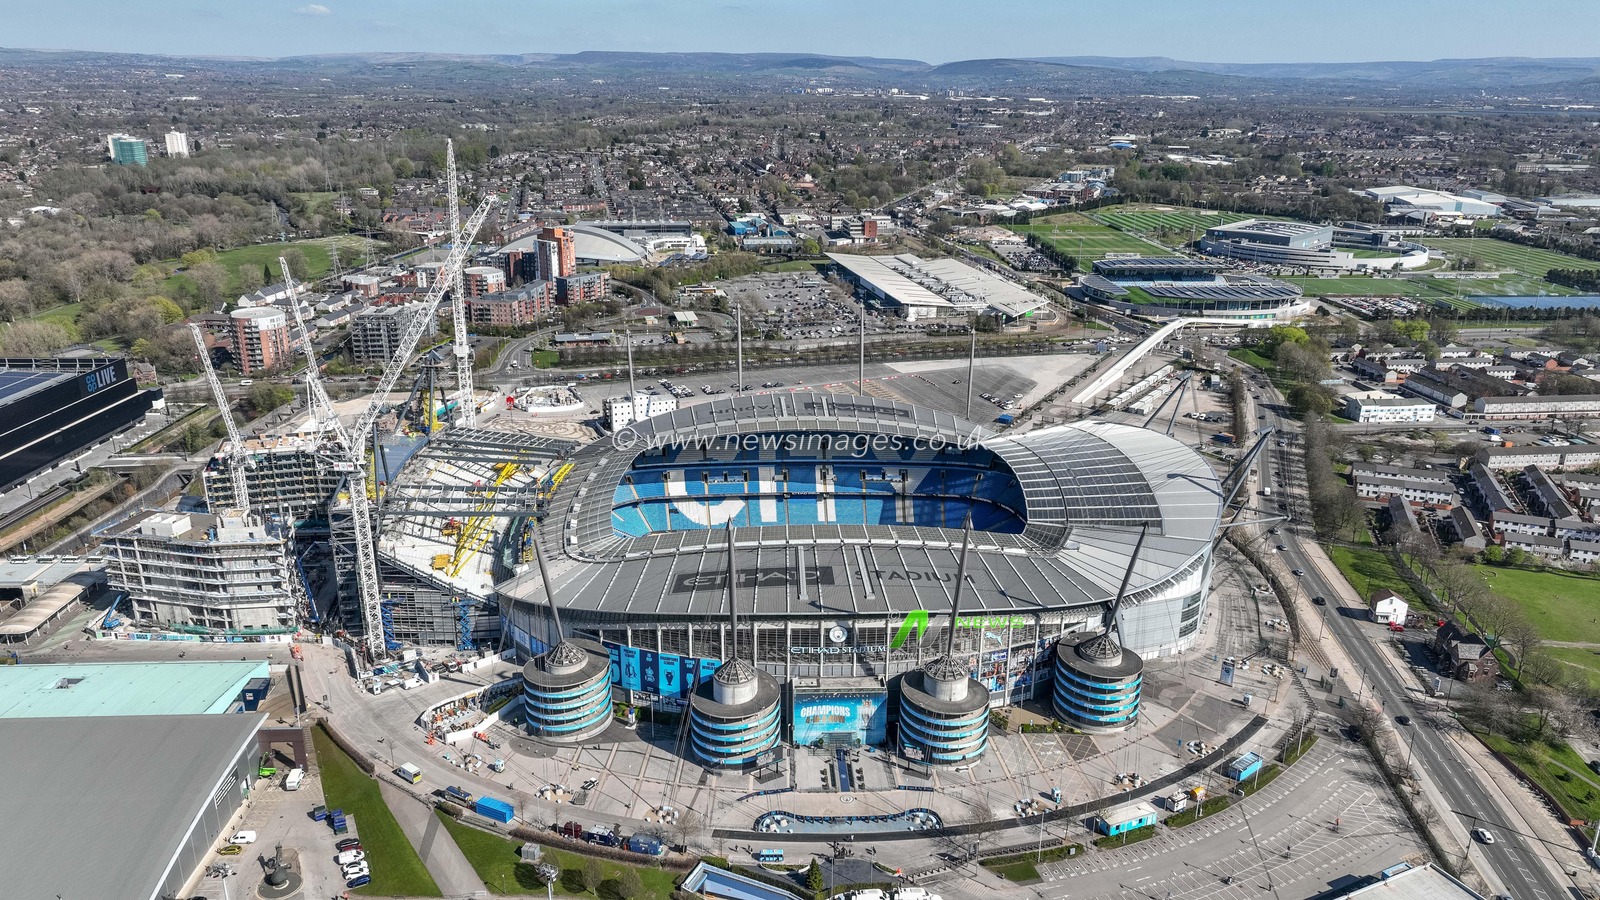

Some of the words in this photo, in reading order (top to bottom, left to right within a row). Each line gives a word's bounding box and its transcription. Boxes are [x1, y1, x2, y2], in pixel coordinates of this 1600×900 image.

[96, 366, 116, 387] LIVE
[791, 646, 839, 654] ETIHAD
[842, 645, 886, 653] STADIUM
[800, 705, 851, 717] CHAMPIONS
